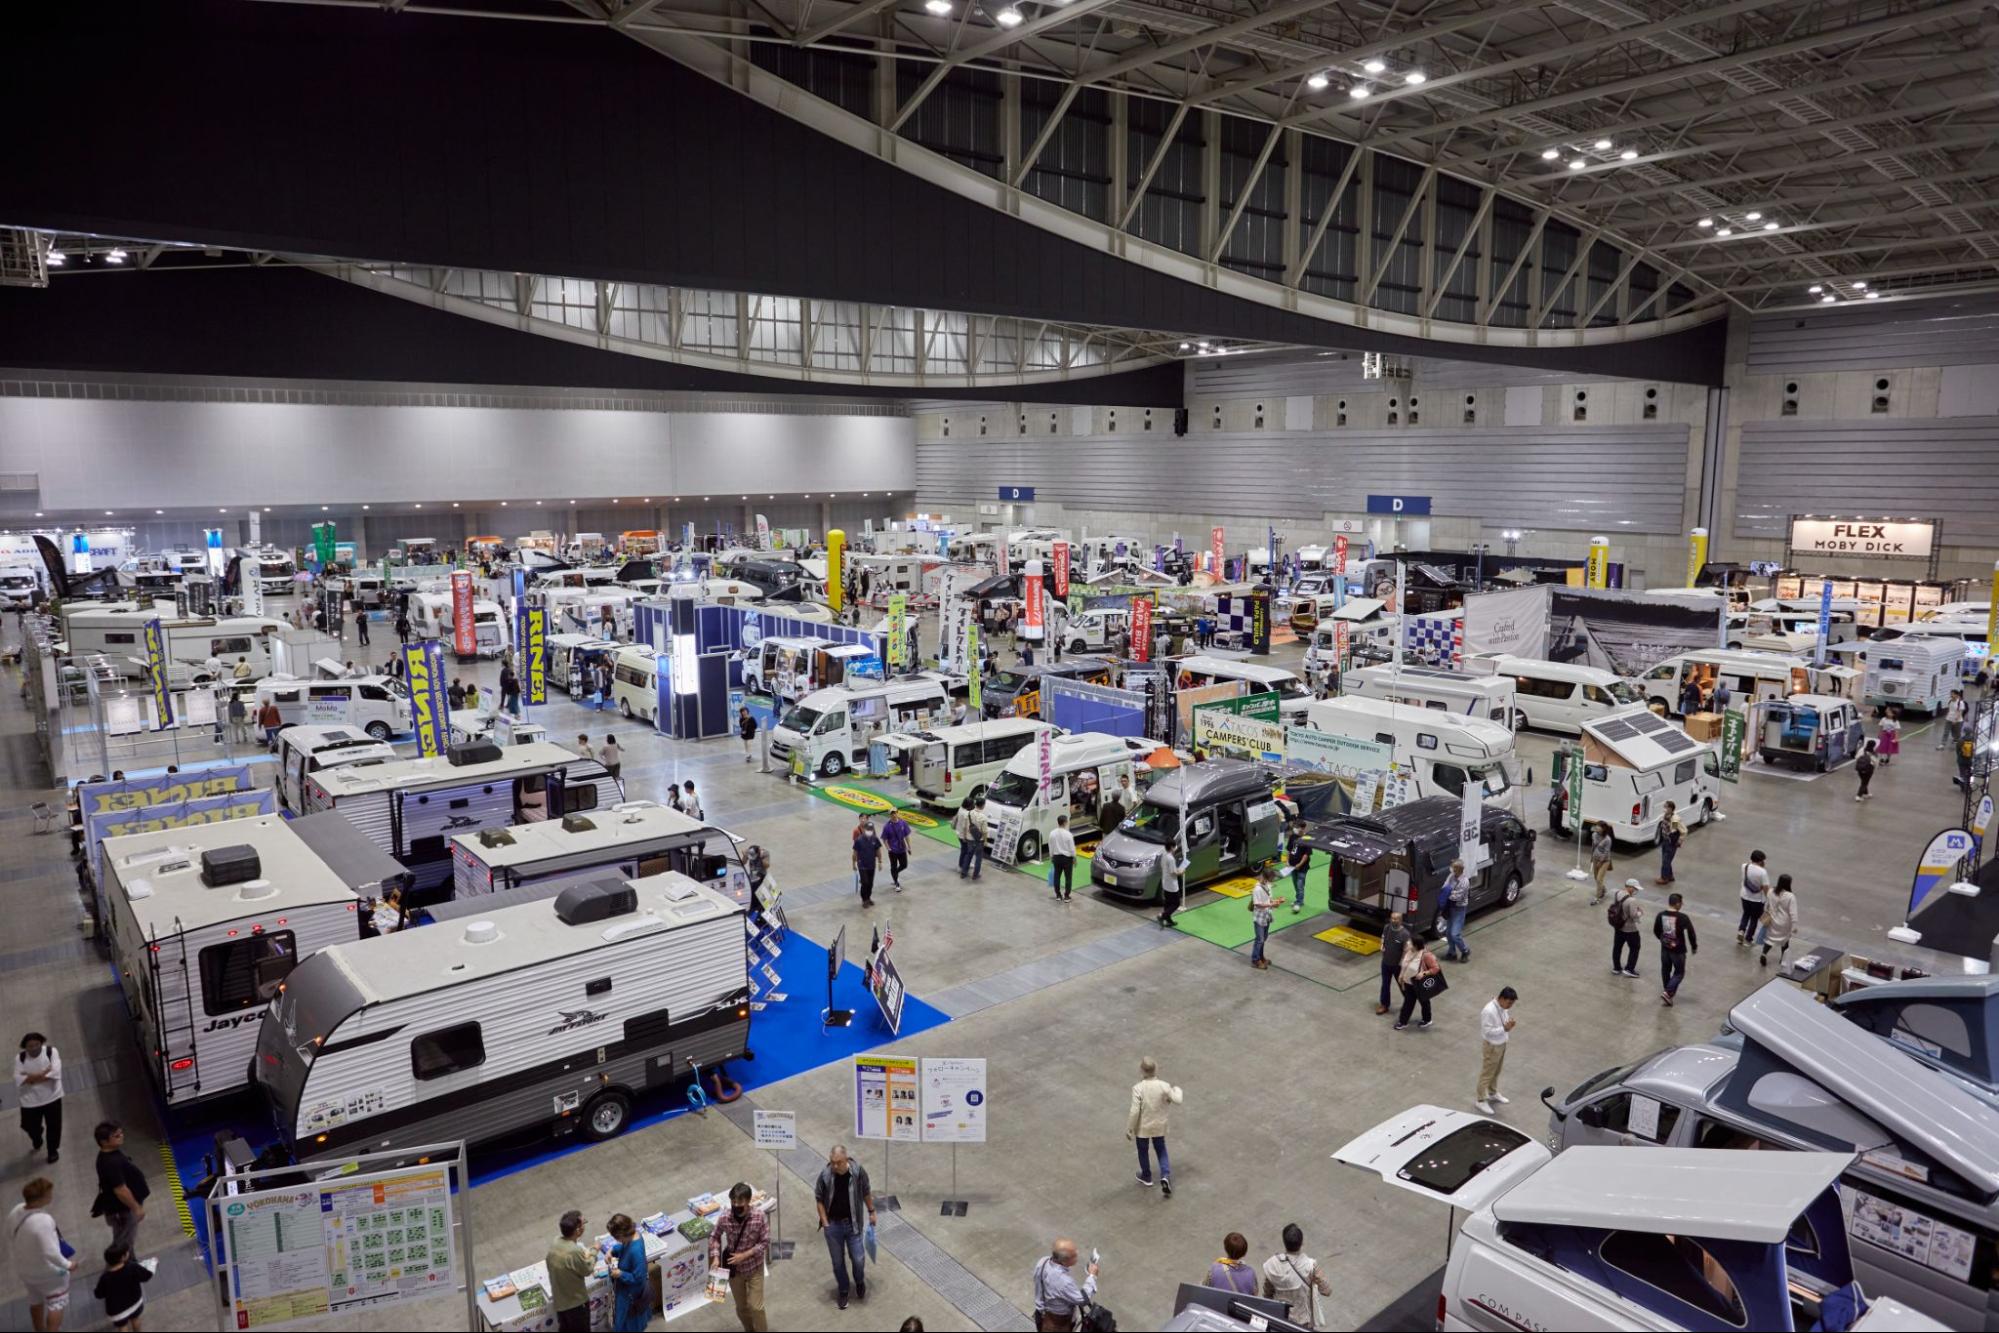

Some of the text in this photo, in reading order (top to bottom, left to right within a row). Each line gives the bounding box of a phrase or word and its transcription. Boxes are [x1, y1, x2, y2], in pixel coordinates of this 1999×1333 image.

[1013, 489, 1020, 499] D
[1392, 498, 1404, 511] D
[1834, 524, 1886, 538] FLEX
[1814, 541, 1904, 552] MOBY DICK
[1136, 600, 1145, 627] PAPA
[1253, 600, 1261, 645] PAPA BUILD
[528, 609, 545, 703] RINEI
[1249, 738, 1272, 752] CLUB
[203, 1009, 266, 1033] Jayco
